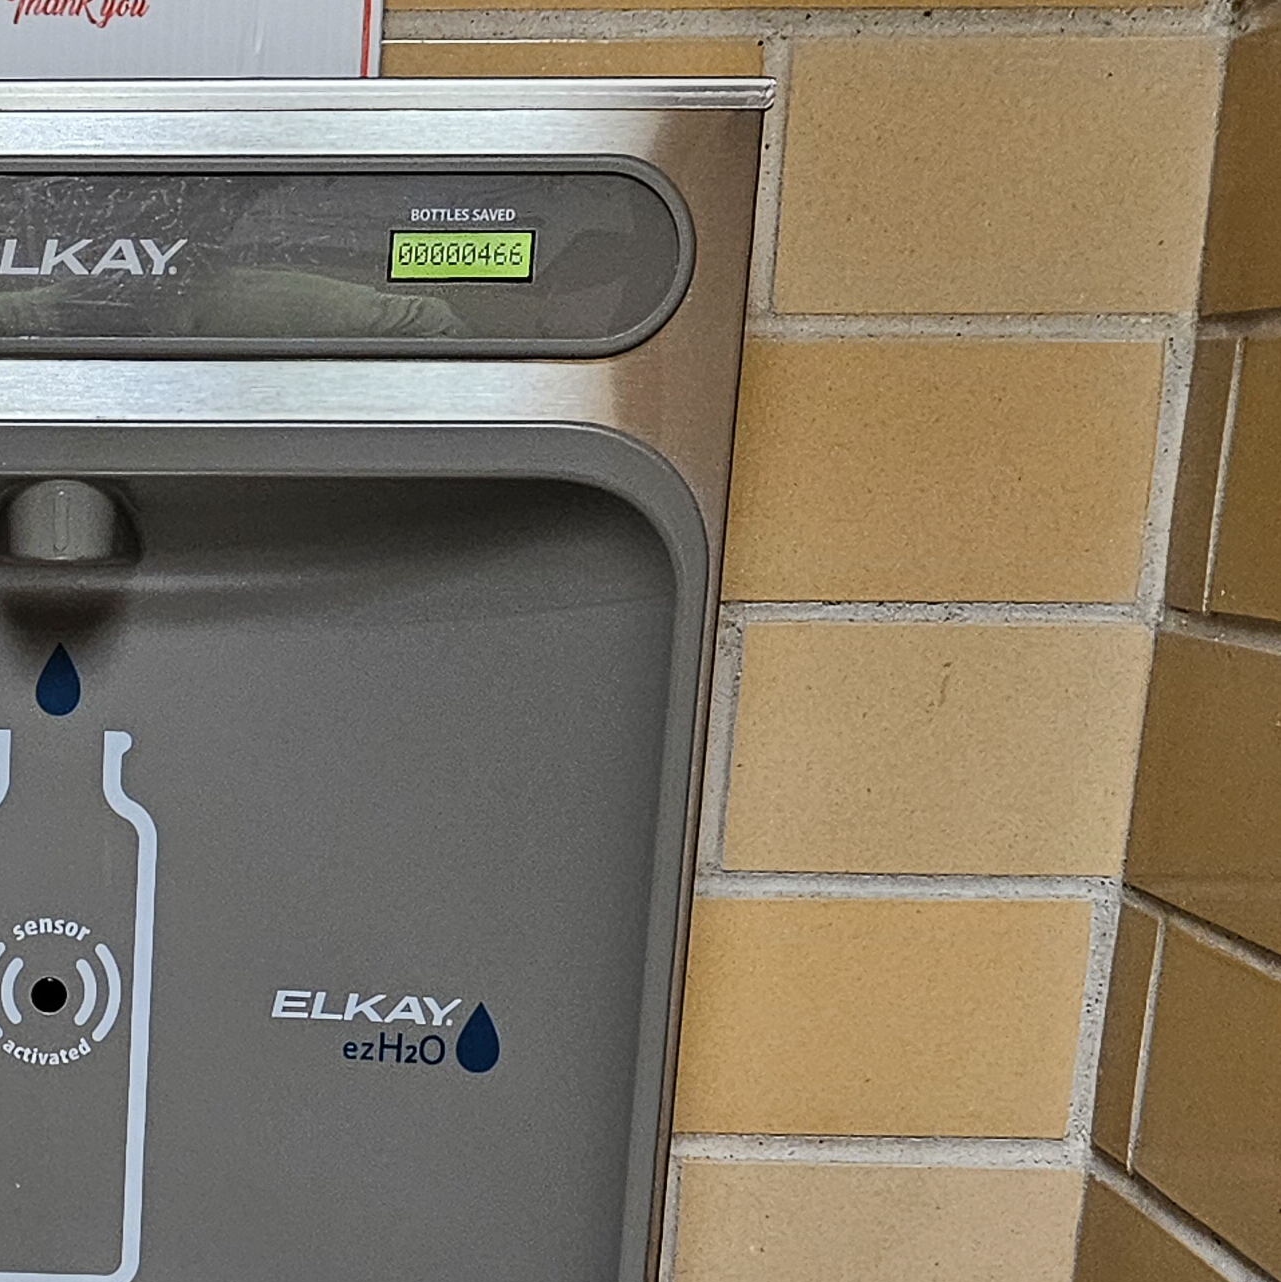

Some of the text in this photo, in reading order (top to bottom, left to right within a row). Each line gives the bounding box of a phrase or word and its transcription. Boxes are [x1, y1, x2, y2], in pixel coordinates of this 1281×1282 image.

[96, 0, 150, 28] you
[410, 208, 516, 222] BOTTLES SAVED
[398, 242, 524, 266] 00000466
[12, 917, 91, 941] sensor
[2, 1037, 92, 1066] activated
